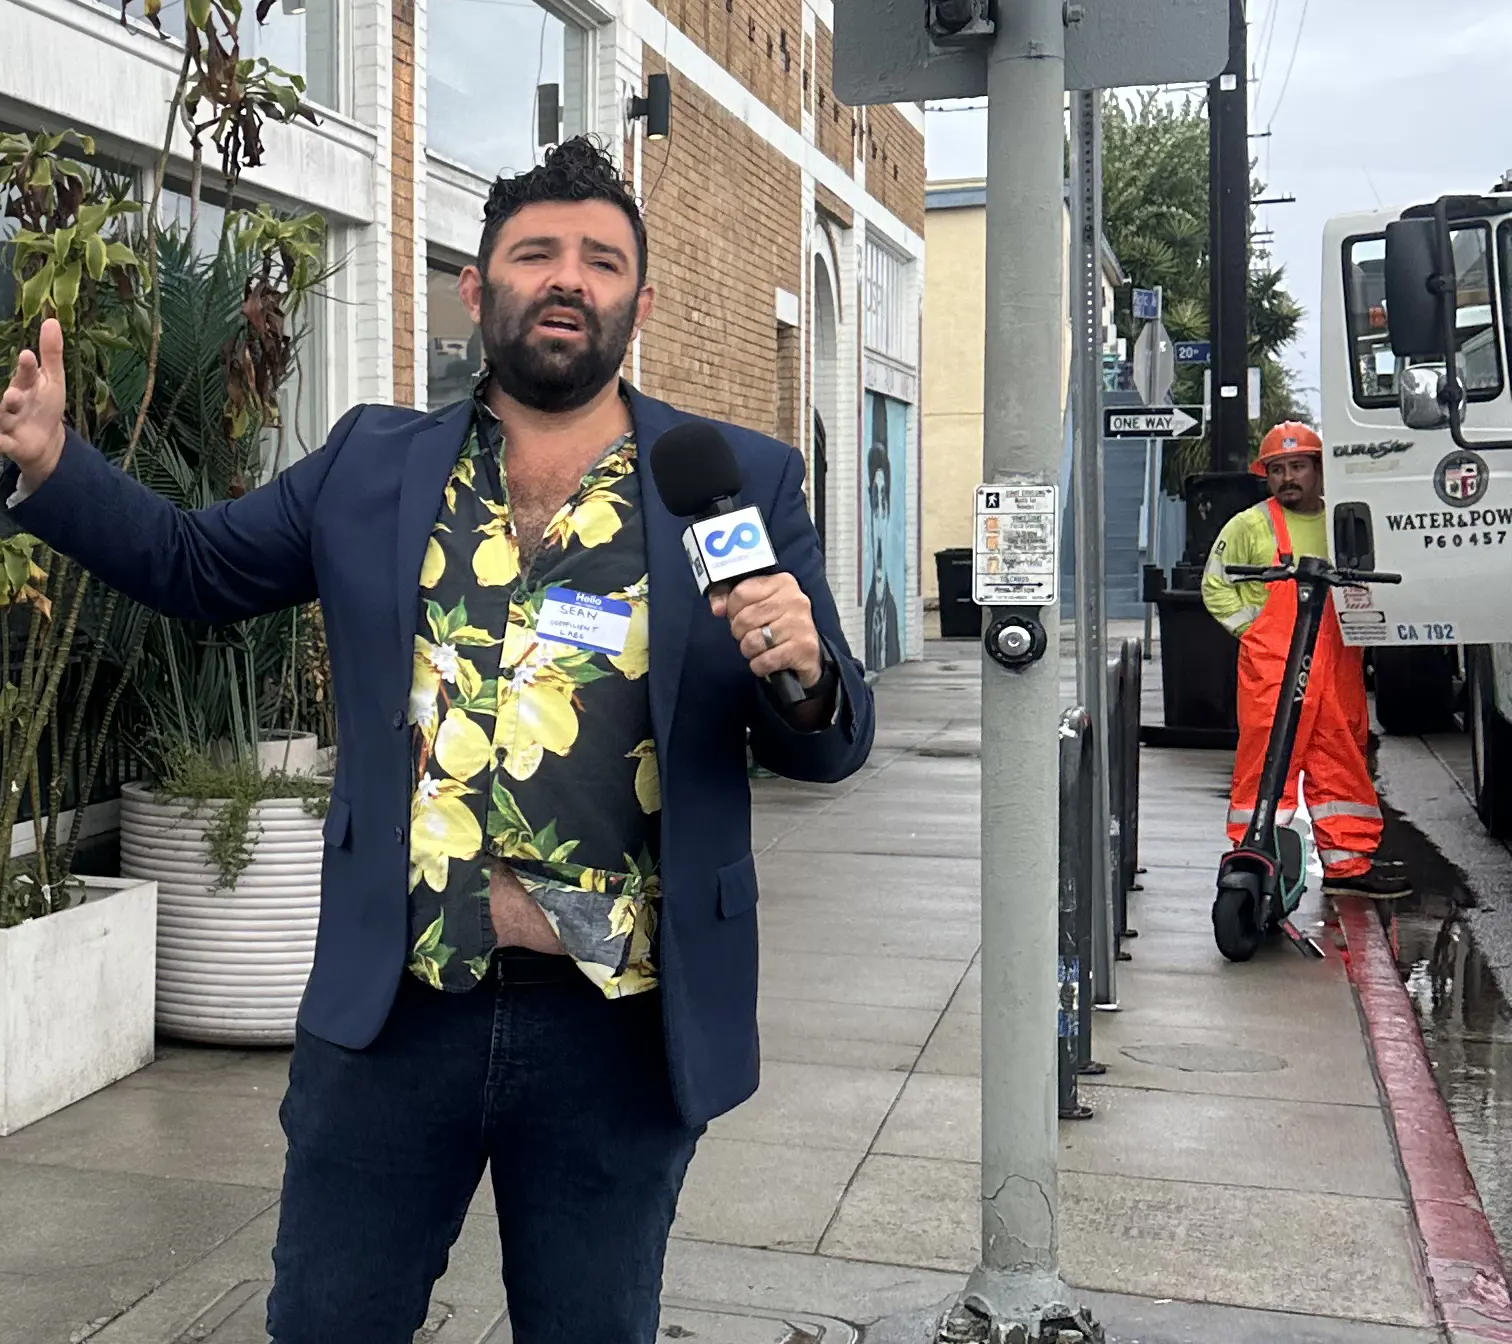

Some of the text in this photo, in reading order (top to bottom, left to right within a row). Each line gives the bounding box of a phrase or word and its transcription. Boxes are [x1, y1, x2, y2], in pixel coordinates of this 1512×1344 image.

[1113, 416, 1173, 430] ONE WAY
[575, 592, 603, 606] Hello
[559, 604, 598, 621] SEAN
[1396, 624, 1419, 641] CA
